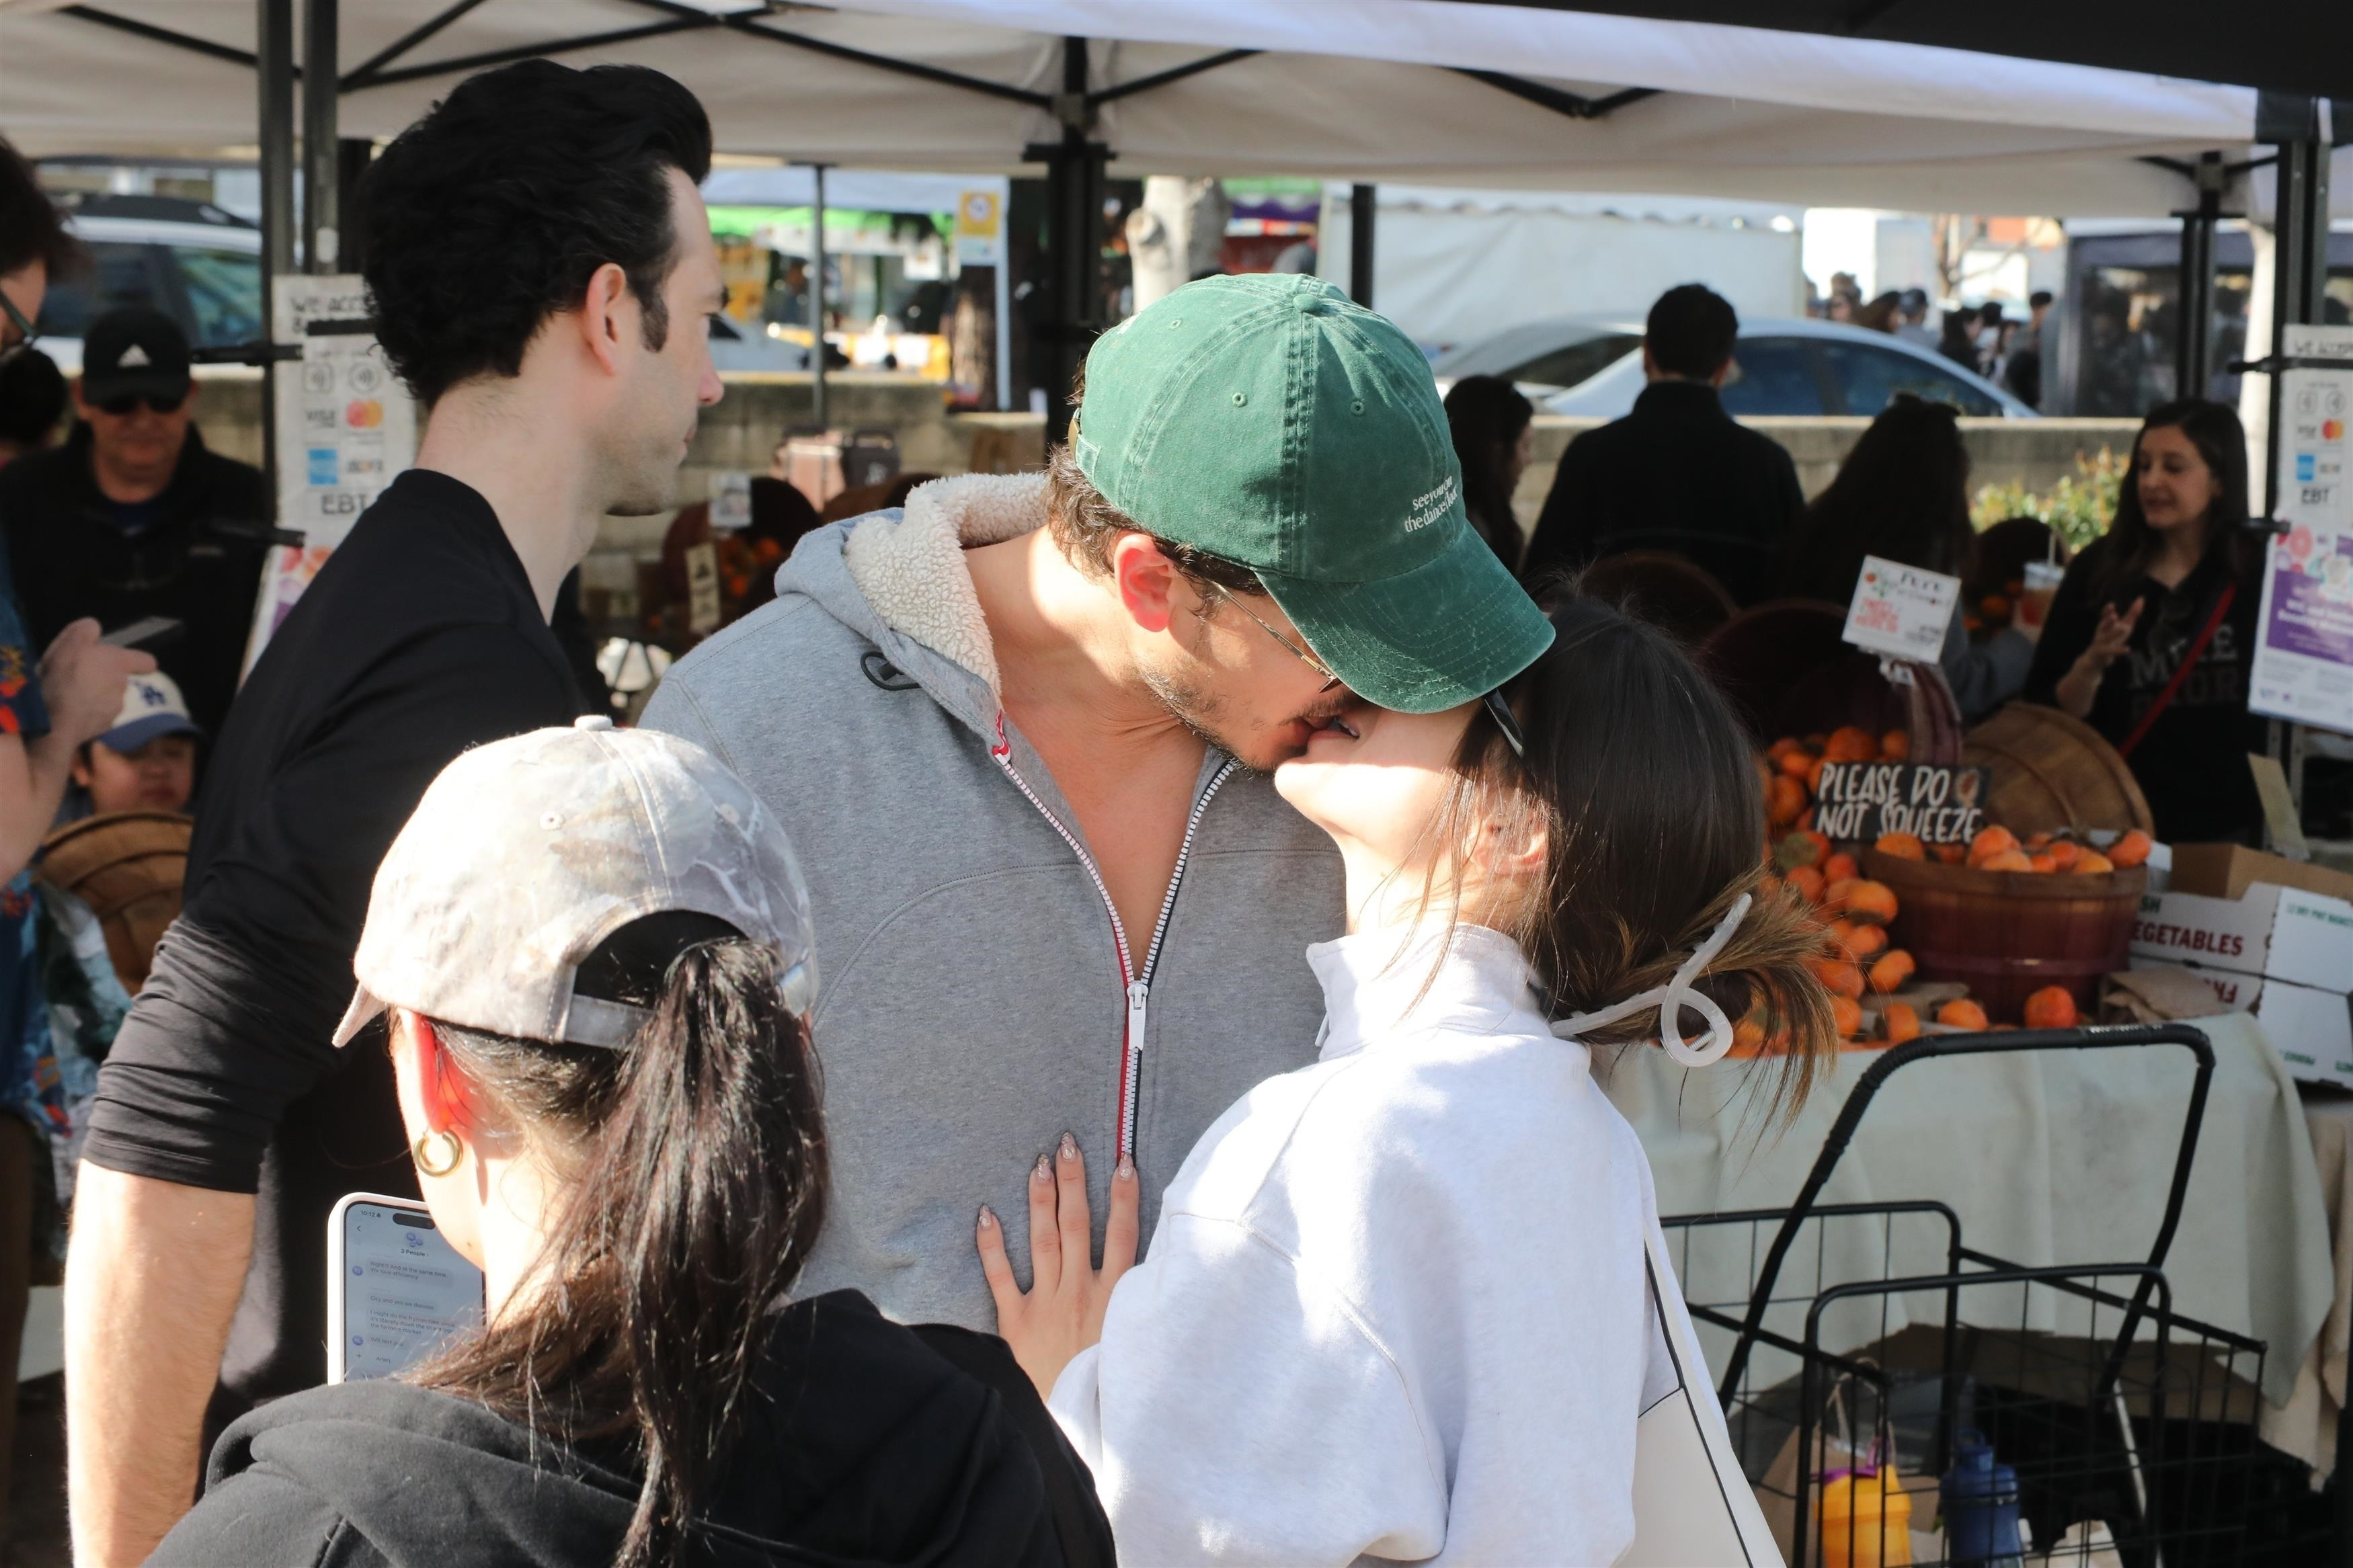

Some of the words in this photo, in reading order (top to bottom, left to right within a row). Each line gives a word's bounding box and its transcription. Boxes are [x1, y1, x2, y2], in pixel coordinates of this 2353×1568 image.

[1819, 761, 1903, 805] PLEASE
[1911, 765, 1951, 807] DO
[1817, 802, 1870, 839] NOT
[1877, 803, 1983, 844] SQUEEZE
[2132, 919, 2244, 957] EGETABLES
[405, 1249, 426, 1258] People
[403, 1327, 422, 1335] market
